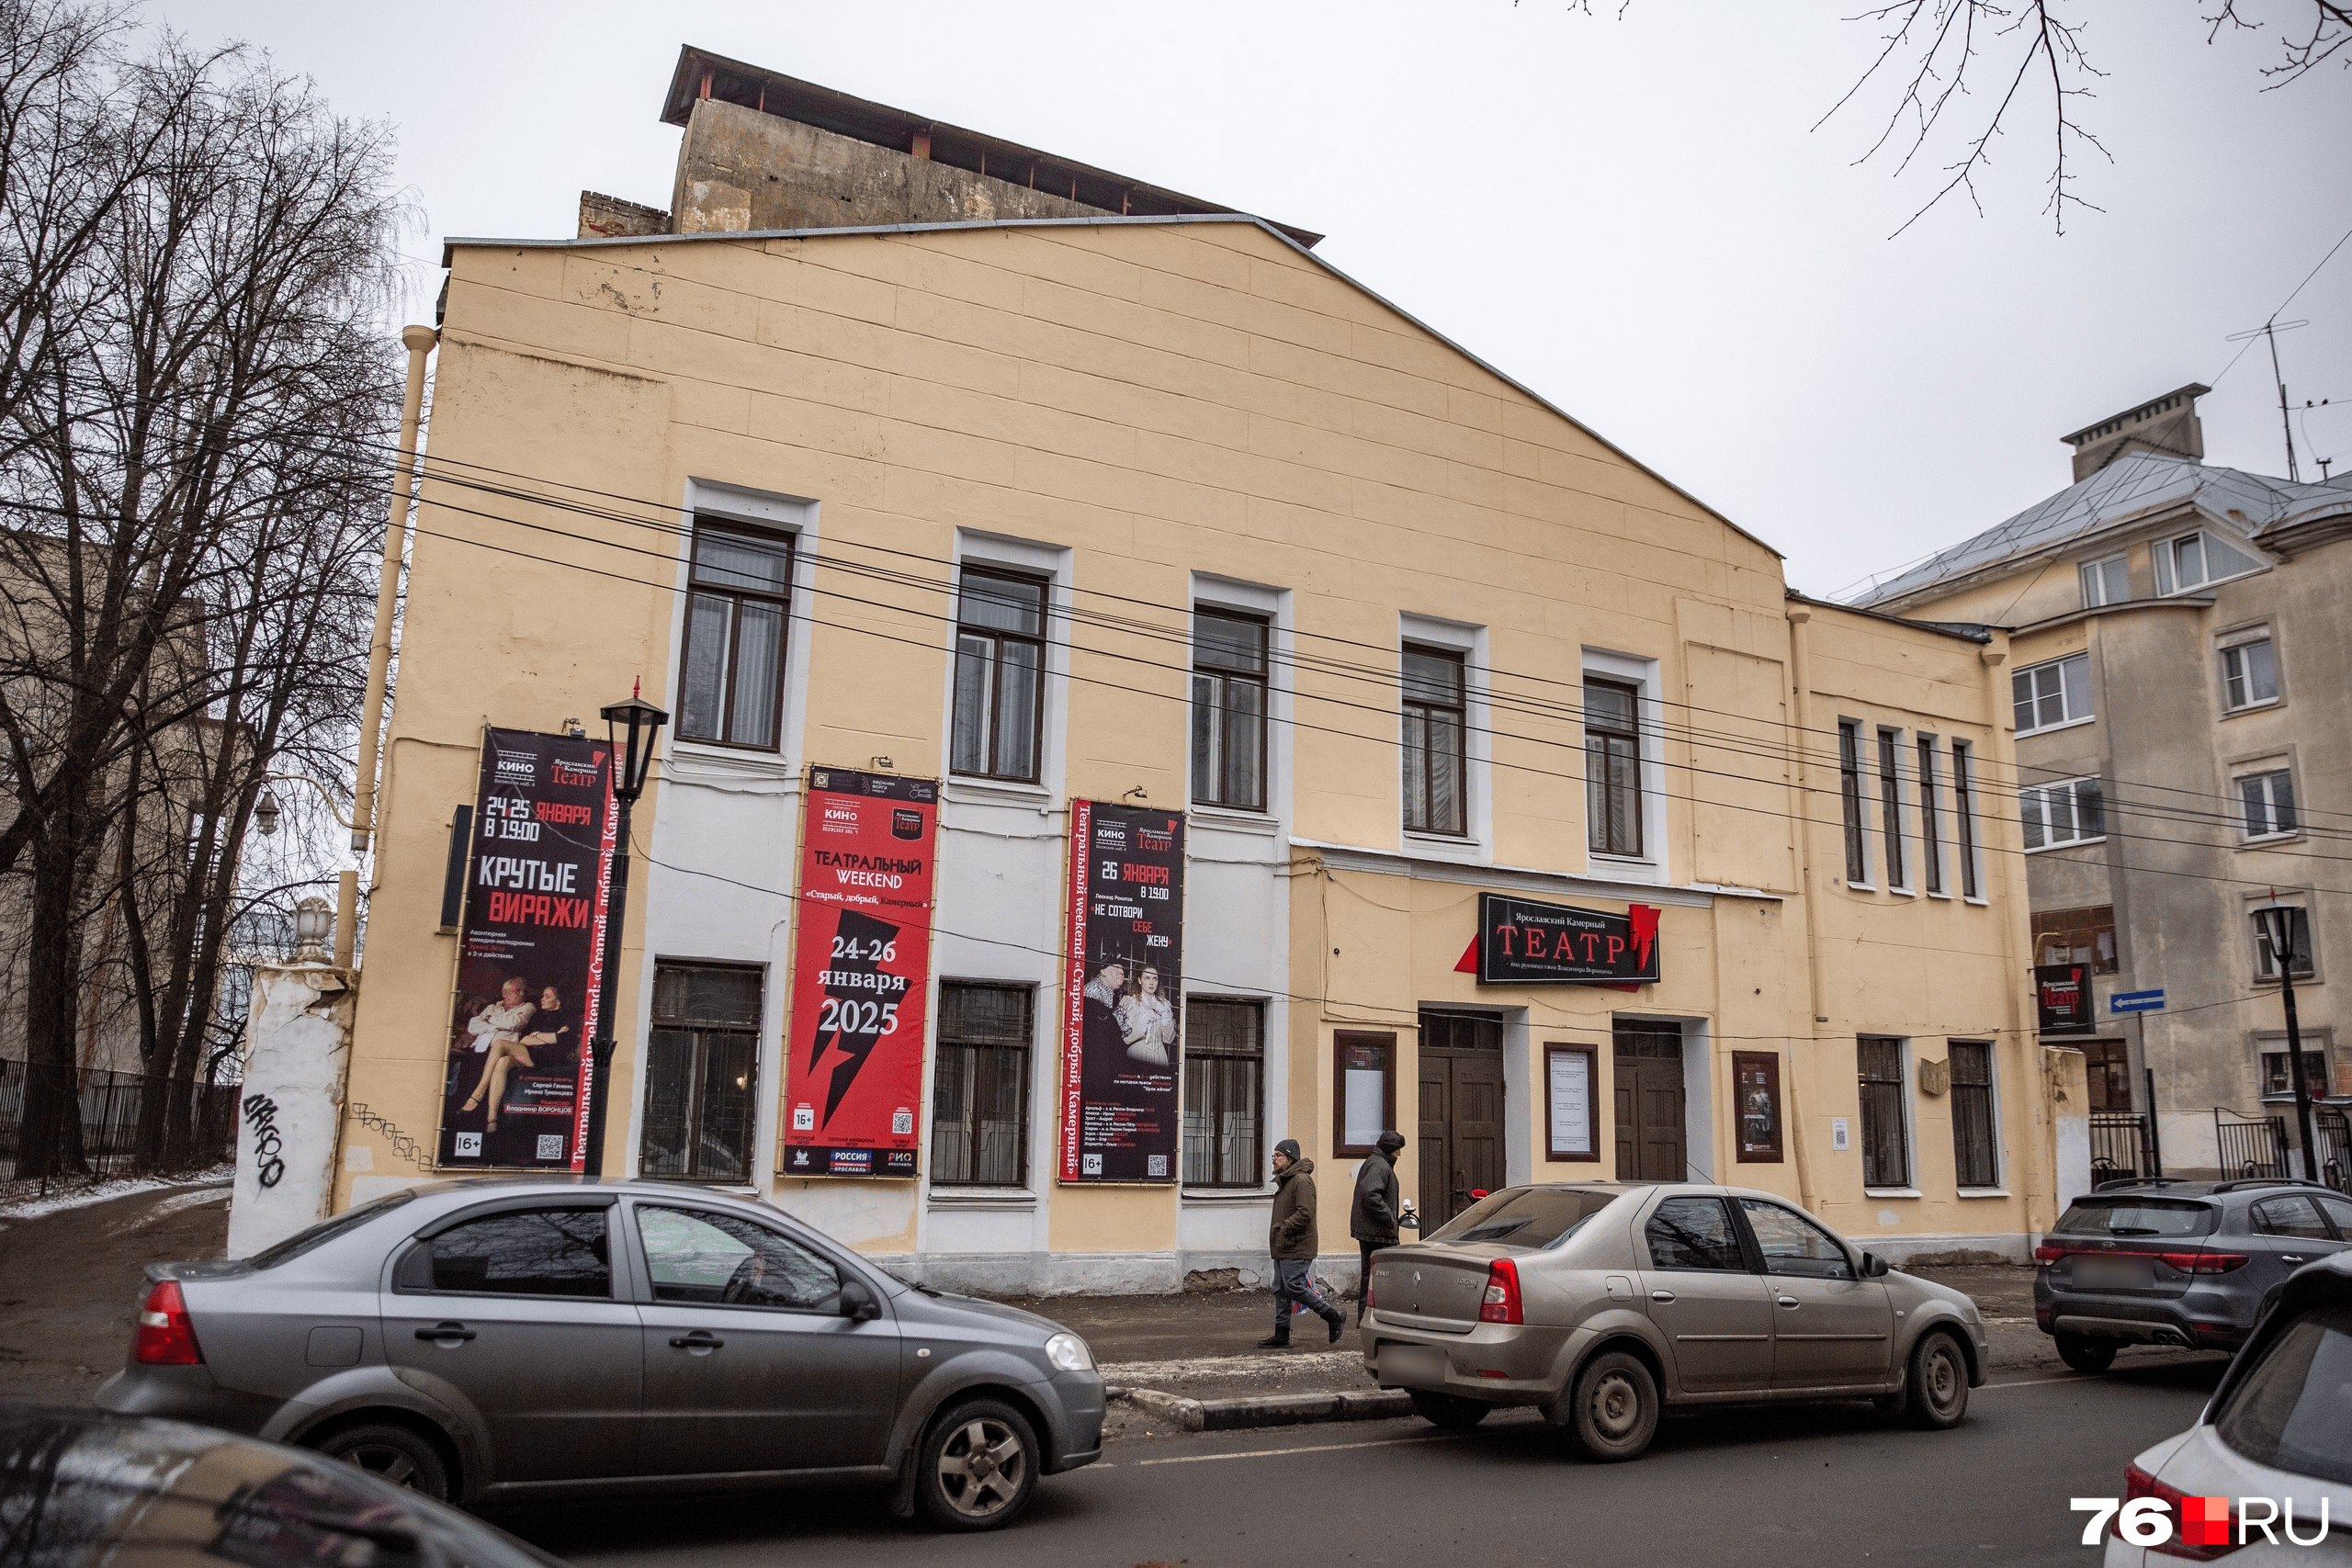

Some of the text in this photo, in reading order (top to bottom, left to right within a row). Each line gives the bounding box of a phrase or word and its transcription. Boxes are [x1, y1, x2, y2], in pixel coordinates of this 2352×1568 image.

[498, 761, 534, 773] КИНО
[551, 766, 596, 787] Театр
[486, 796, 507, 816] 24
[510, 799, 530, 819] 25
[535, 801, 591, 825] ЯНВАРЯ
[825, 809, 857, 821] КИНО
[484, 818, 540, 842] В 19:00
[894, 817, 920, 831] Театр
[1098, 829, 1125, 840] КИНО
[1137, 833, 1171, 851] Театр
[814, 850, 922, 875] ТЕАТРАЛЬНЫЙ
[479, 855, 578, 893] КРУТЫЕ
[836, 869, 903, 889] WEEKEND
[1102, 861, 1169, 885] 26 ЯНВАРЯ
[806, 889, 927, 909] «Старый, добрый, Камерный»
[1141, 886, 1169, 900] В 19:00
[488, 891, 589, 929] ВИРАЖИ
[1091, 903, 1143, 919] «НЕ СОТВОРИ
[1133, 920, 1153, 933] СЕБЕ
[1515, 912, 1605, 930] Ярославский Камерный
[831, 936, 896, 962] 24-26
[1147, 935, 1172, 947] ЖЕНУ»
[1496, 925, 1625, 964] ТЕАТР
[817, 969, 906, 995] января
[1065, 806, 1090, 1175] Театральный weekend: «Старый, добрый, Камерный»
[2041, 987, 2080, 1014] Театр
[819, 998, 899, 1035] 2025
[796, 1114, 812, 1125] 16+
[458, 1138, 480, 1150] 16+
[835, 1152, 867, 1160] РОССИЯ
[888, 1153, 912, 1161] РИО
[1085, 1158, 1101, 1169] 16+
